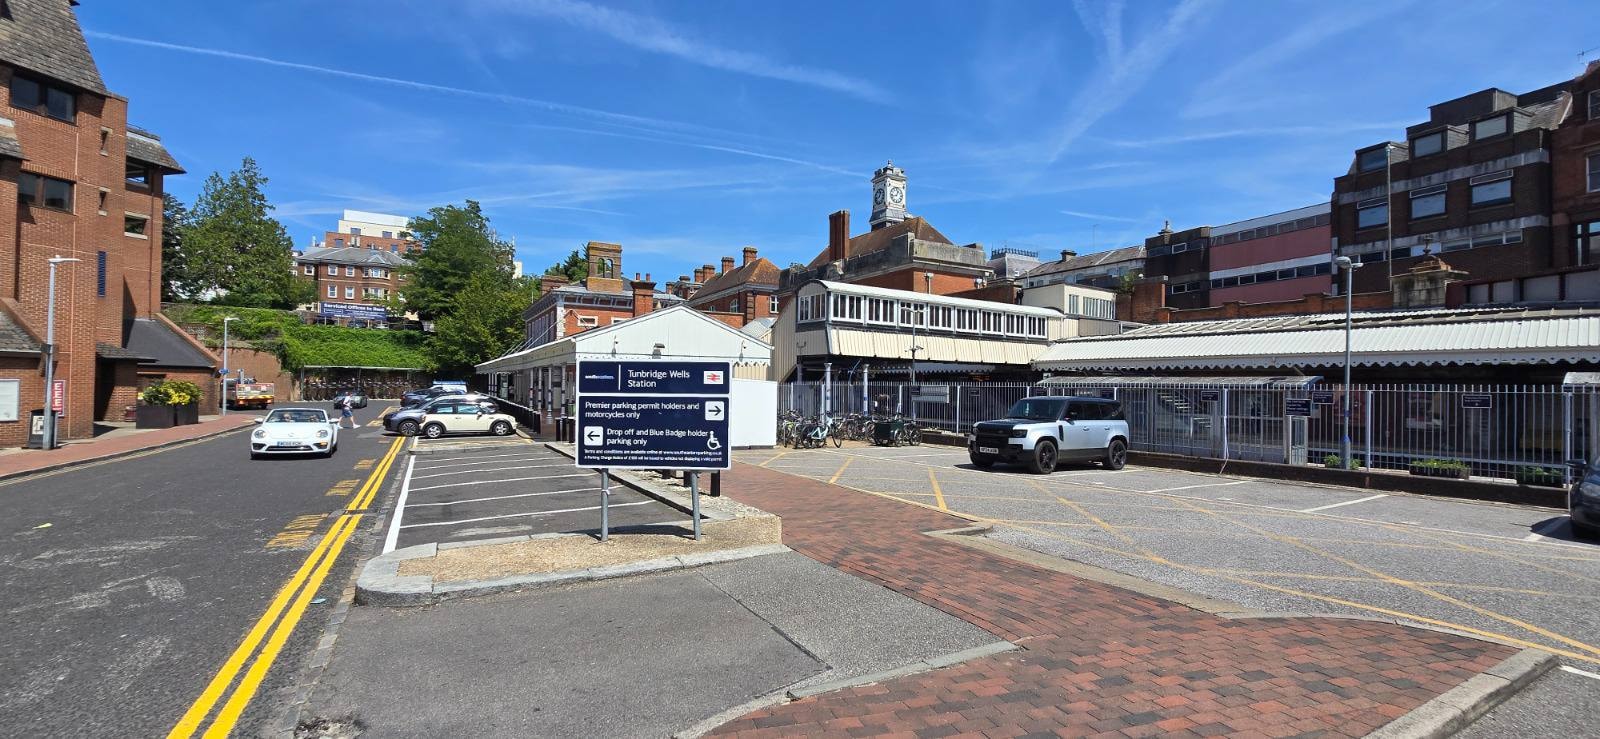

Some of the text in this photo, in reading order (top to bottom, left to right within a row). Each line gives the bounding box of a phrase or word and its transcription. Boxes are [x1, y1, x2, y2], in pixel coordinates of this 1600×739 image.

[628, 370, 690, 380] Tunbridge Wells
[612, 402, 636, 410] parking
[638, 402, 660, 410] permit
[585, 411, 624, 419] motorcycles
[665, 429, 686, 438] Badge
